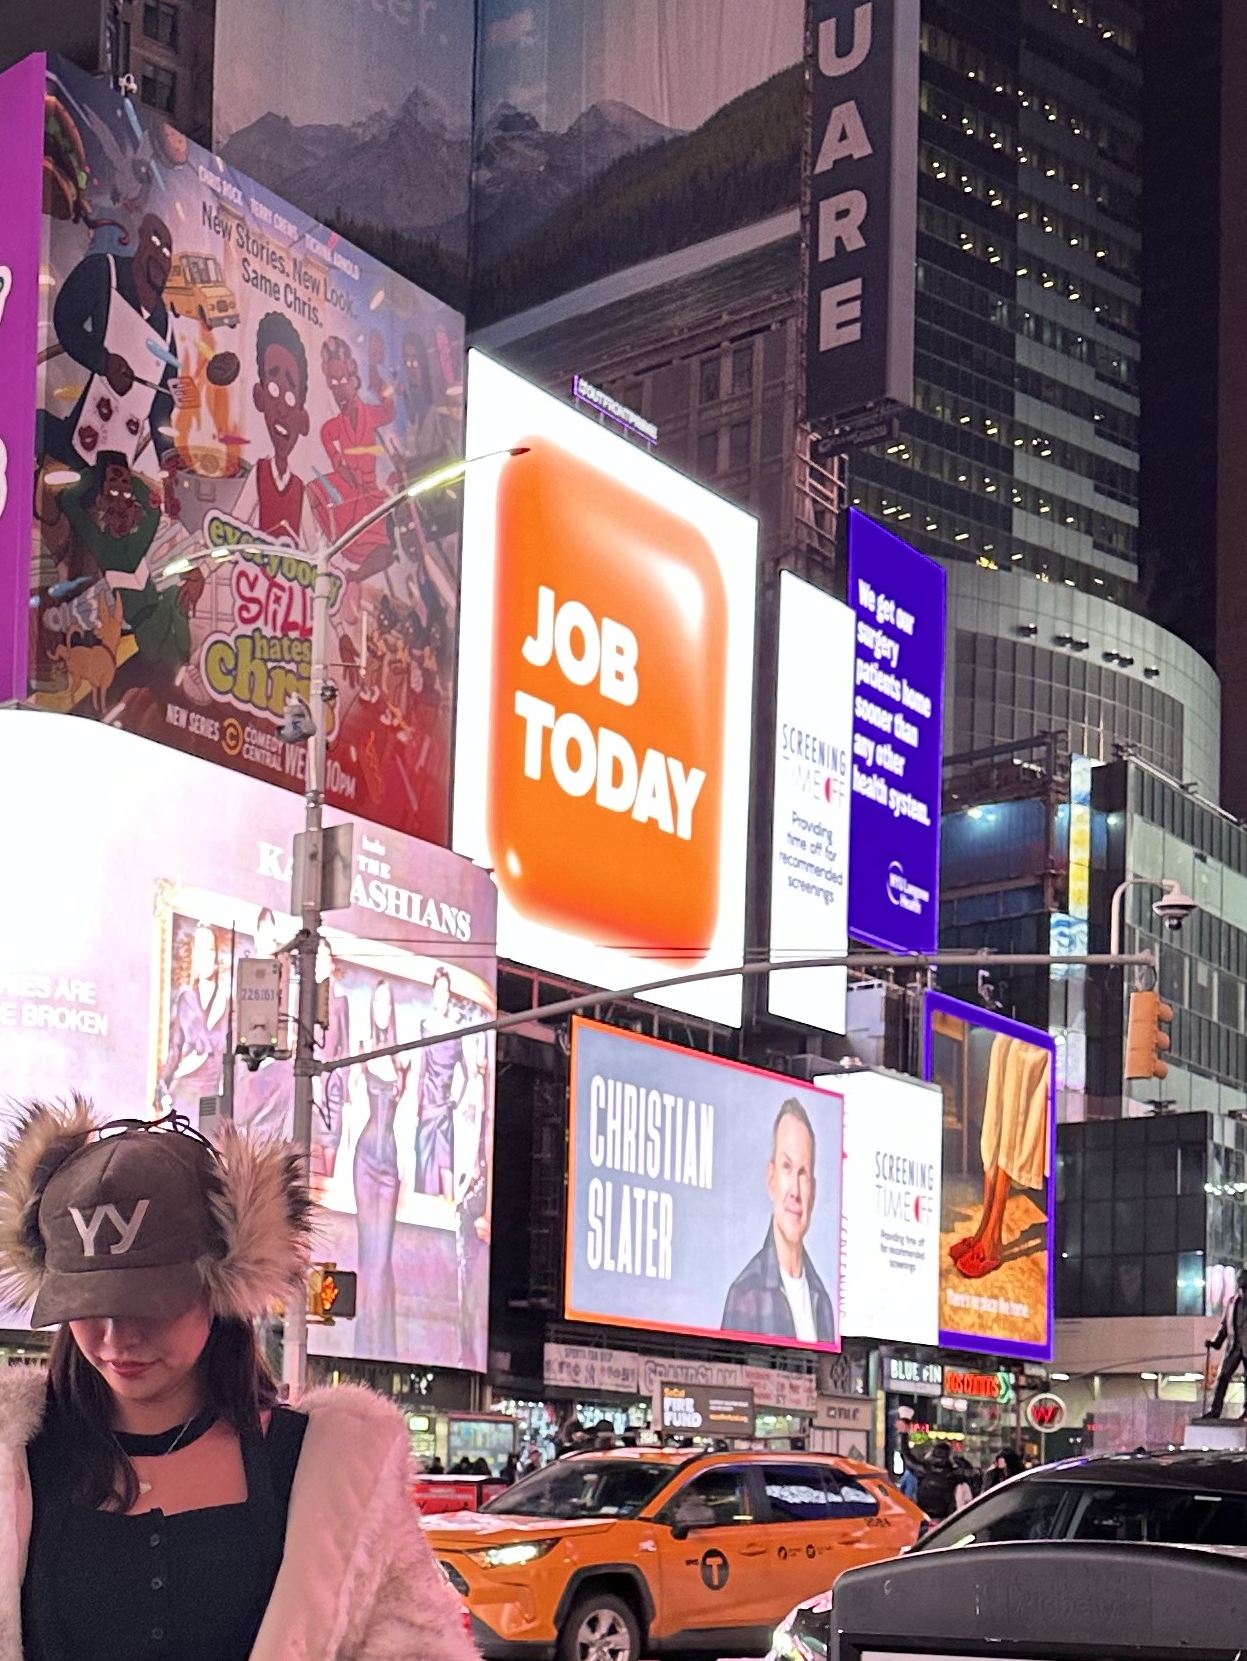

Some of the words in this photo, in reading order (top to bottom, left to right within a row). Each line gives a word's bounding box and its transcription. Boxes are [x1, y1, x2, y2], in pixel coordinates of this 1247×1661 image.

[202, 201, 232, 243] New
[236, 222, 290, 278] Stories.
[292, 255, 321, 296] New
[242, 257, 281, 302] Same
[284, 283, 324, 328] Chris.
[858, 578, 876, 612] We
[876, 593, 895, 626] get
[895, 607, 916, 636] our
[521, 584, 639, 707] JOB
[857, 620, 900, 669] surgery
[856, 657, 901, 702] patients
[901, 678, 932, 719] home
[165, 703, 189, 734] NEW
[189, 711, 220, 742] SERIES
[855, 695, 893, 734] sooner
[893, 712, 920, 749] than
[243, 742, 283, 772] CENTRAL
[515, 689, 707, 841] TODAY
[782, 723, 847, 777] SCREENING
[853, 732, 875, 767] any
[875, 743, 906, 777] other
[792, 810, 833, 847] Providing
[357, 854, 391, 880] THE
[779, 851, 843, 886] recommended
[788, 875, 834, 906] screenings
[54, 976, 97, 1005] ARE
[21, 1003, 109, 1037] BROKEN
[589, 1074, 715, 1189] CHRISTIAN
[875, 1151, 934, 1191] SCREENING
[587, 1177, 674, 1281] SLATER
[890, 1358, 920, 1381] BLUE
[922, 1363, 942, 1383] FIN
